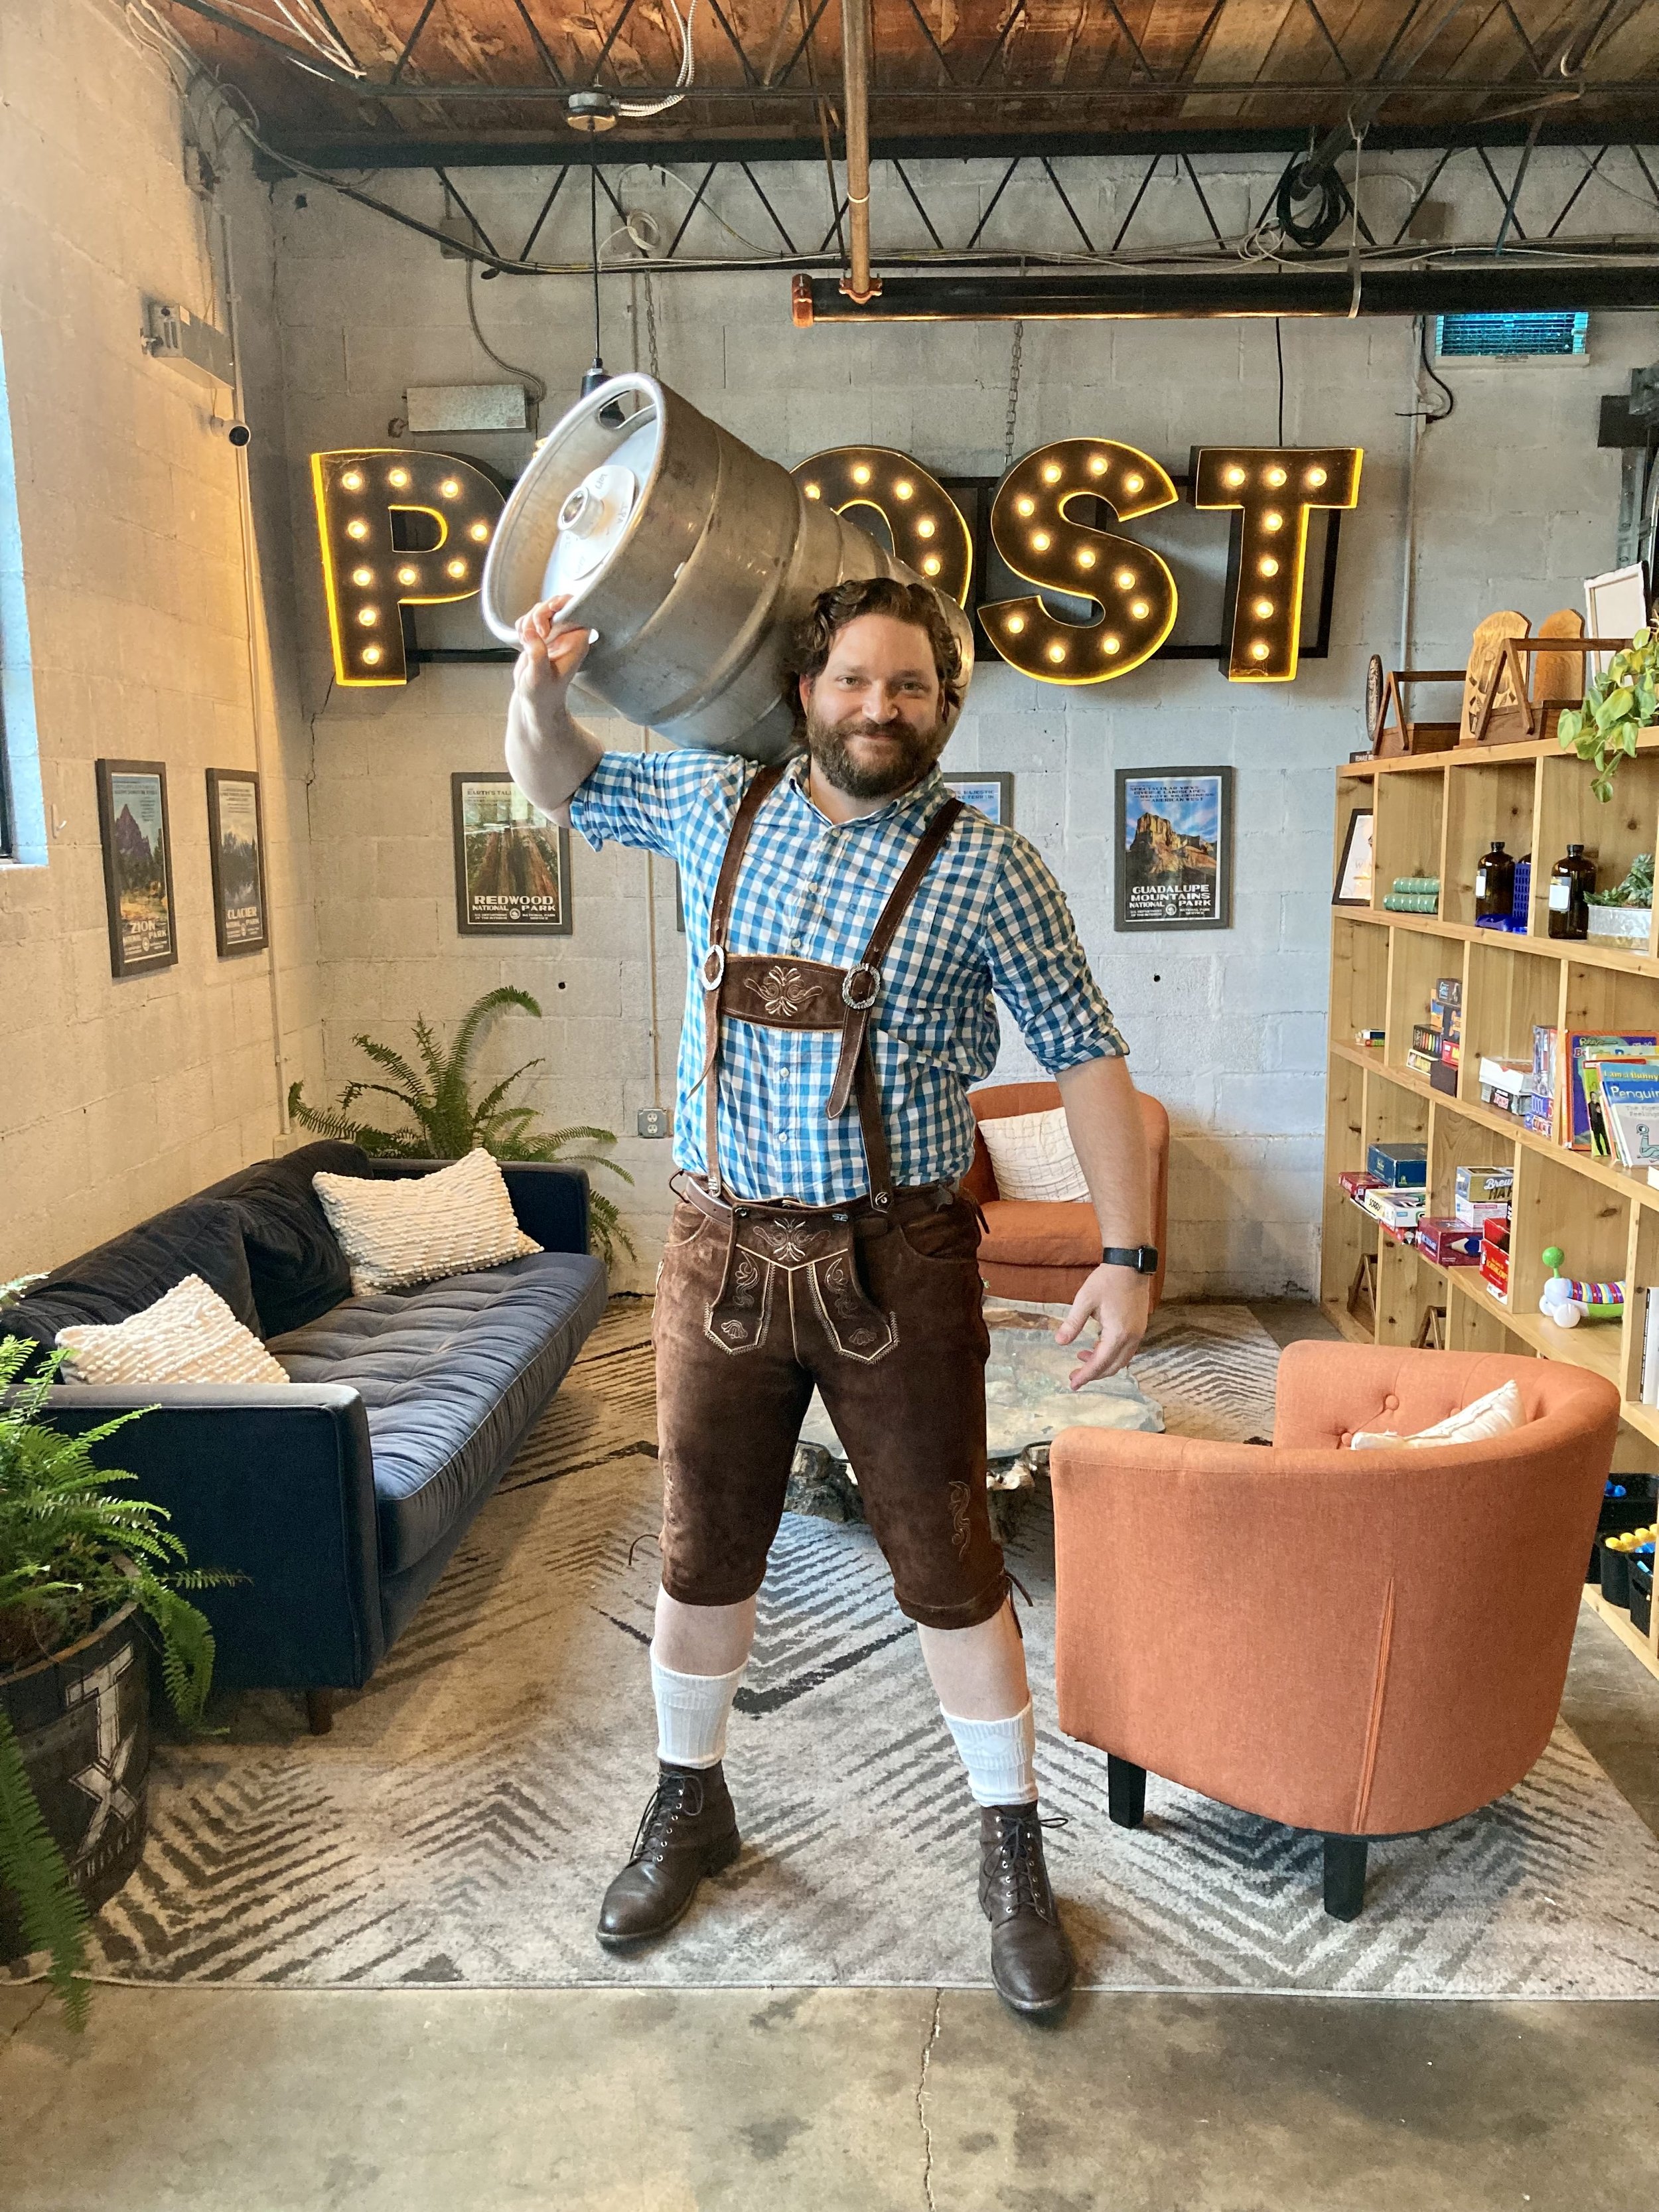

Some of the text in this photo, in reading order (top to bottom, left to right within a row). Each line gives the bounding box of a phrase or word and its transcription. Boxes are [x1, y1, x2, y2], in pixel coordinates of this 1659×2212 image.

[1132, 884, 1210, 895] GUADALUPE
[474, 895, 553, 905] REDWOOD
[1130, 893, 1210, 902] MOUNTAINS
[227, 907, 257, 920] GLACIER
[129, 920, 156, 934] ZION
[148, 929, 167, 940] PARK
[1630, 1071, 1659, 1082] Bunny
